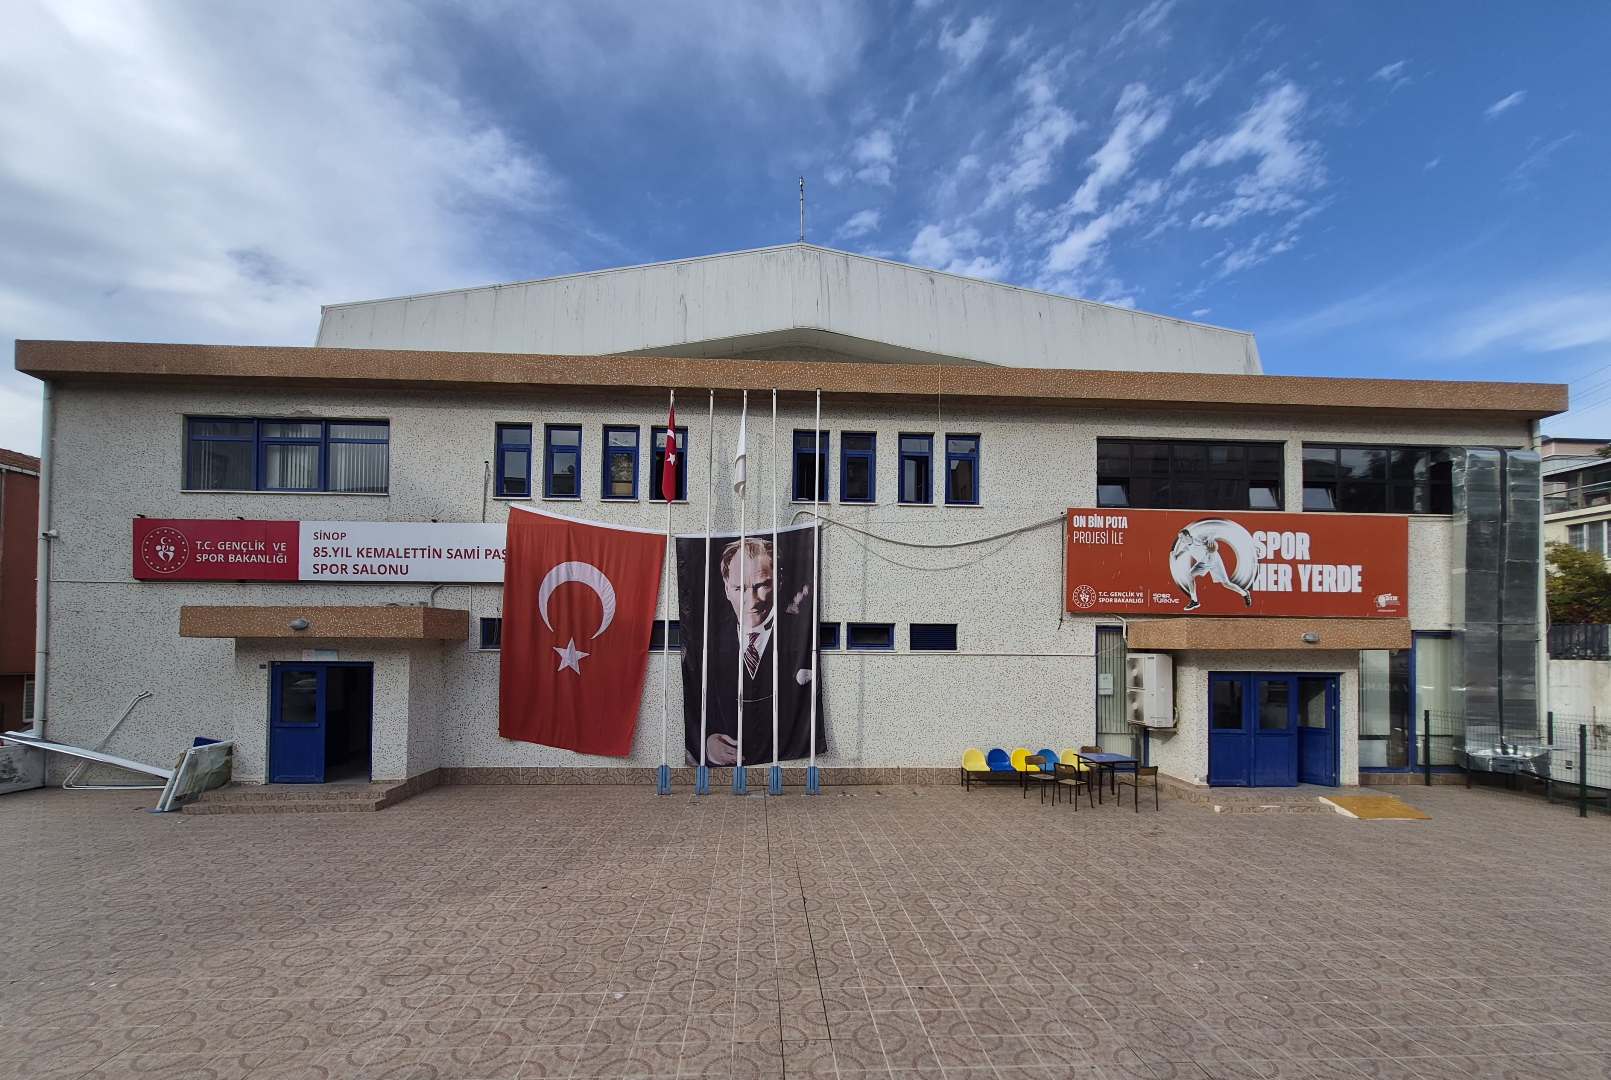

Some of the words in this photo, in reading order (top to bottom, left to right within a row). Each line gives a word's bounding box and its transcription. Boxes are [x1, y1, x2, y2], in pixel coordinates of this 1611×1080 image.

[1073, 515, 1086, 528] ON
[1088, 513, 1104, 528] BİN
[1105, 516, 1128, 529] POTA
[313, 530, 347, 540] SİNOP
[1073, 530, 1109, 545] PROJESİ
[1111, 530, 1124, 545] İLE
[196, 541, 215, 550] T.C.
[218, 540, 265, 553] GENÇLİK
[273, 542, 287, 551] VE
[313, 547, 352, 558] 85.YIL
[357, 545, 442, 559] KEMALETTİN
[446, 546, 480, 560] SAMİ
[1253, 531, 1310, 560] SPOR
[196, 553, 225, 563] SPOR
[229, 553, 287, 564] BAKANLIĞI
[312, 563, 349, 575] SPOR
[352, 563, 409, 576] SALONU
[1253, 563, 1293, 592] HER
[1298, 564, 1362, 593] YERDE
